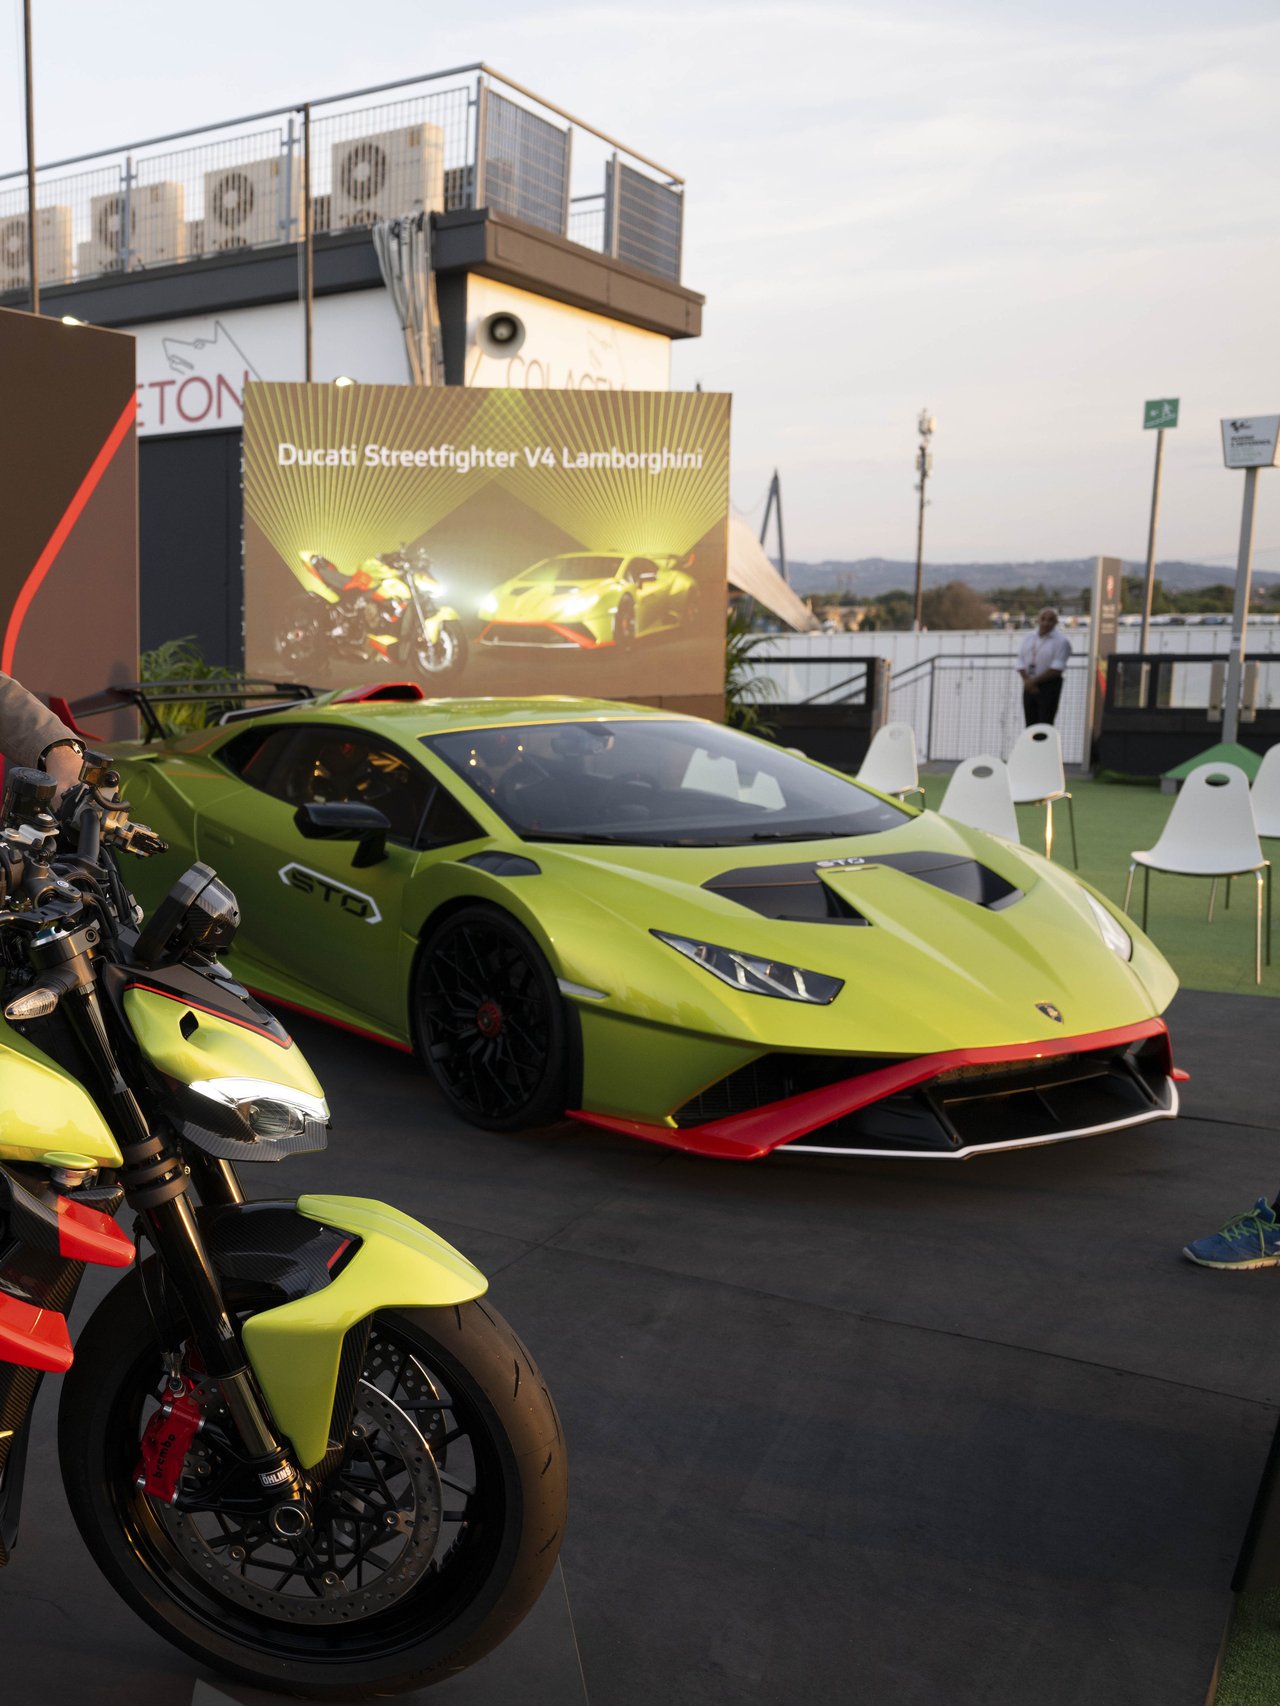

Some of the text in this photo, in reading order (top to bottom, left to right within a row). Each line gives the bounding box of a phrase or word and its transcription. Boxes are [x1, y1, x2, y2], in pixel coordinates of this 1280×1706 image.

[137, 370, 249, 427] TON
[278, 443, 703, 475] Ducati Streetfighter V4 Lamborghini
[291, 870, 369, 918] STO
[153, 1433, 177, 1480] brembo
[262, 1465, 293, 1485] ÖHLINS
